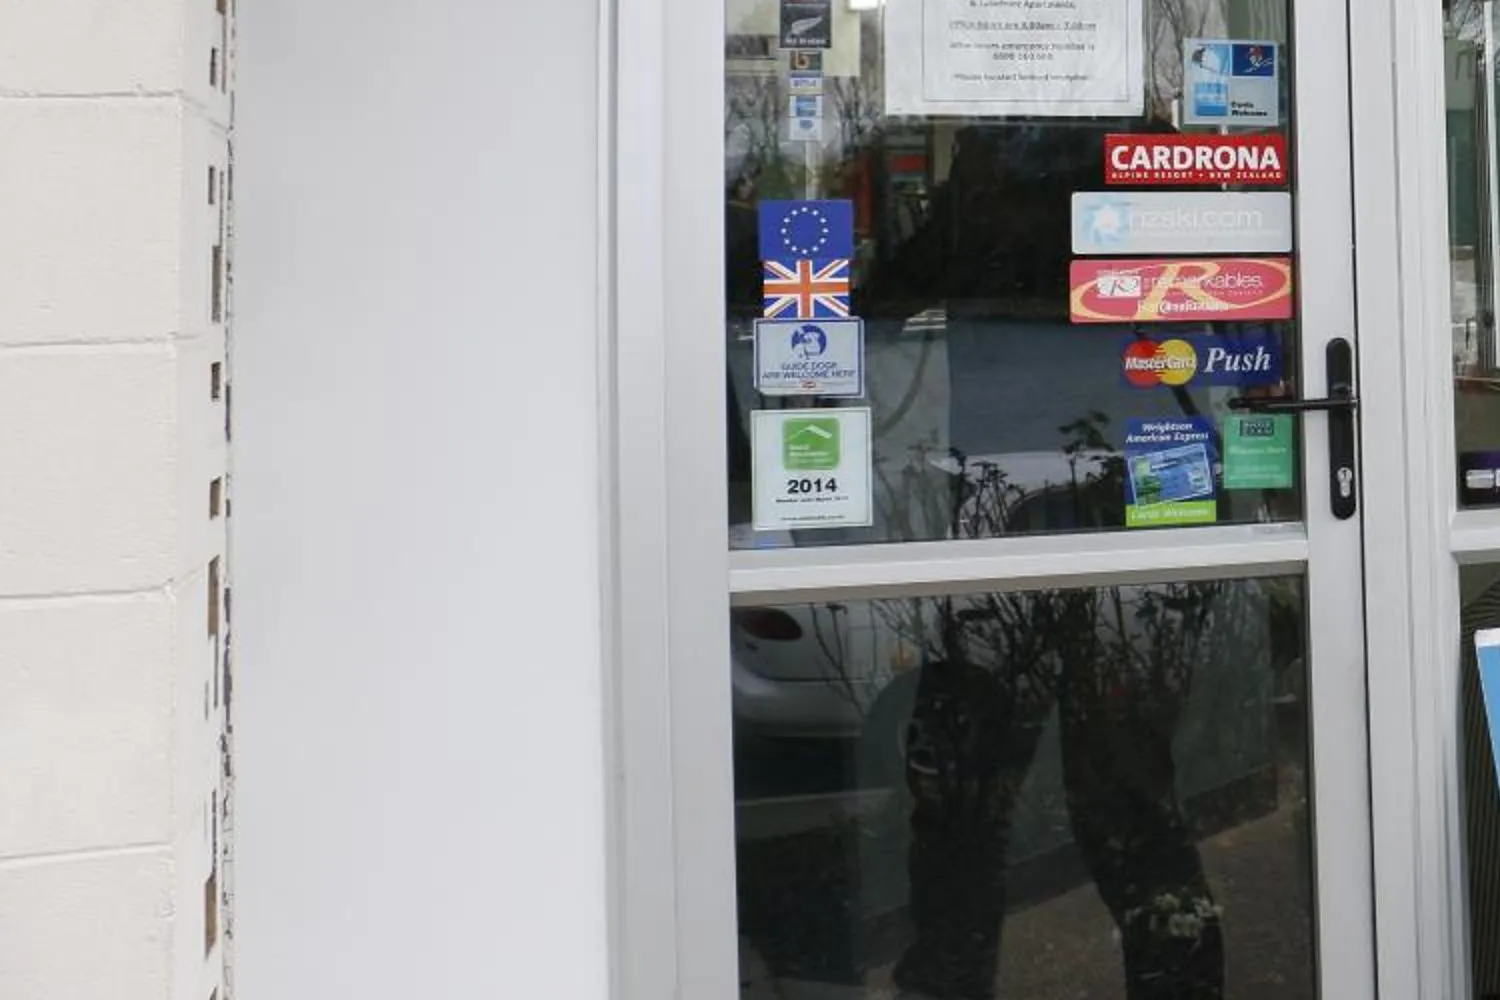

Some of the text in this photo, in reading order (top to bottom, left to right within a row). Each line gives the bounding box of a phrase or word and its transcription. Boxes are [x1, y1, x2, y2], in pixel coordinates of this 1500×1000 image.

[1111, 144, 1281, 170] CARDRONA
[1124, 345, 1272, 373] MasterCard Push
[786, 478, 838, 494] 2014
